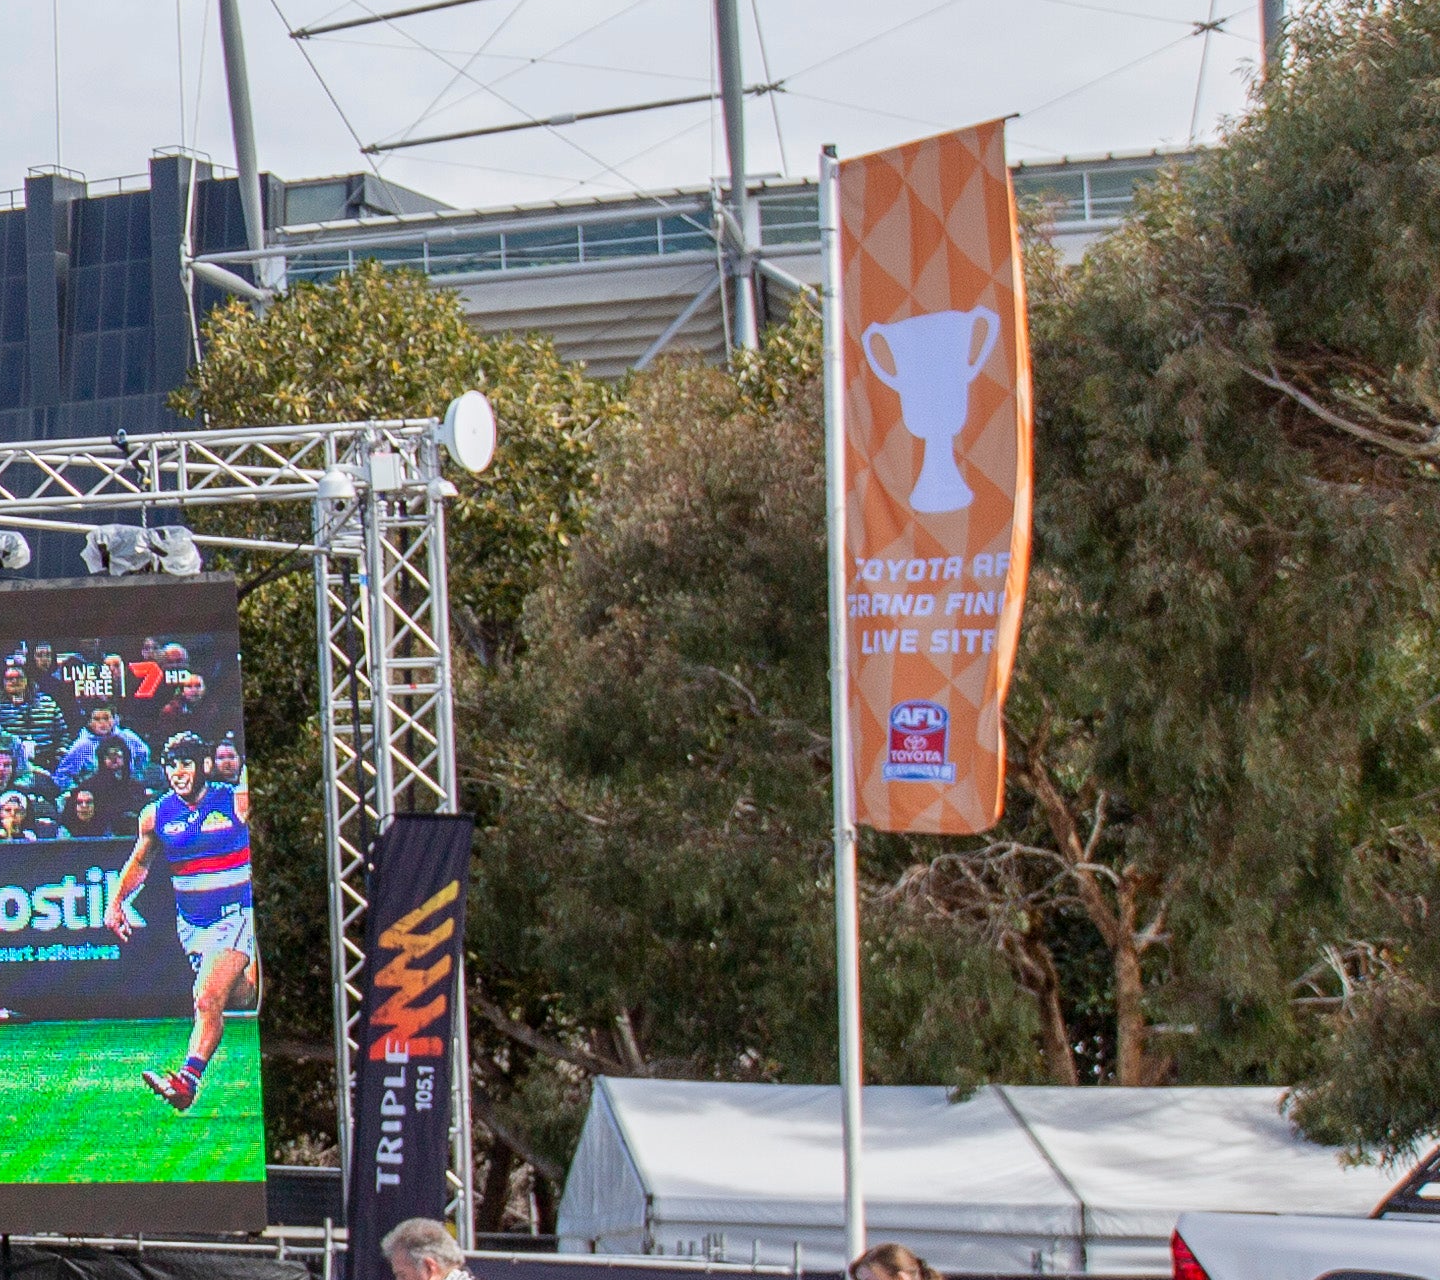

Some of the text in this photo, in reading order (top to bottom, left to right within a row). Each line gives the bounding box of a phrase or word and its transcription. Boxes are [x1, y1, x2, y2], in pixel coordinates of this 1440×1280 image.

[973, 553, 1011, 577] AF
[861, 629, 918, 654] LIVE
[62, 666, 94, 681] LIVE
[128, 662, 165, 699] 7
[74, 679, 114, 697] FREE
[893, 708, 944, 726] AFL
[890, 750, 942, 763] TOYOTA
[415, 1065, 435, 1112] 105.1
[376, 1038, 410, 1194] TRIPLE
